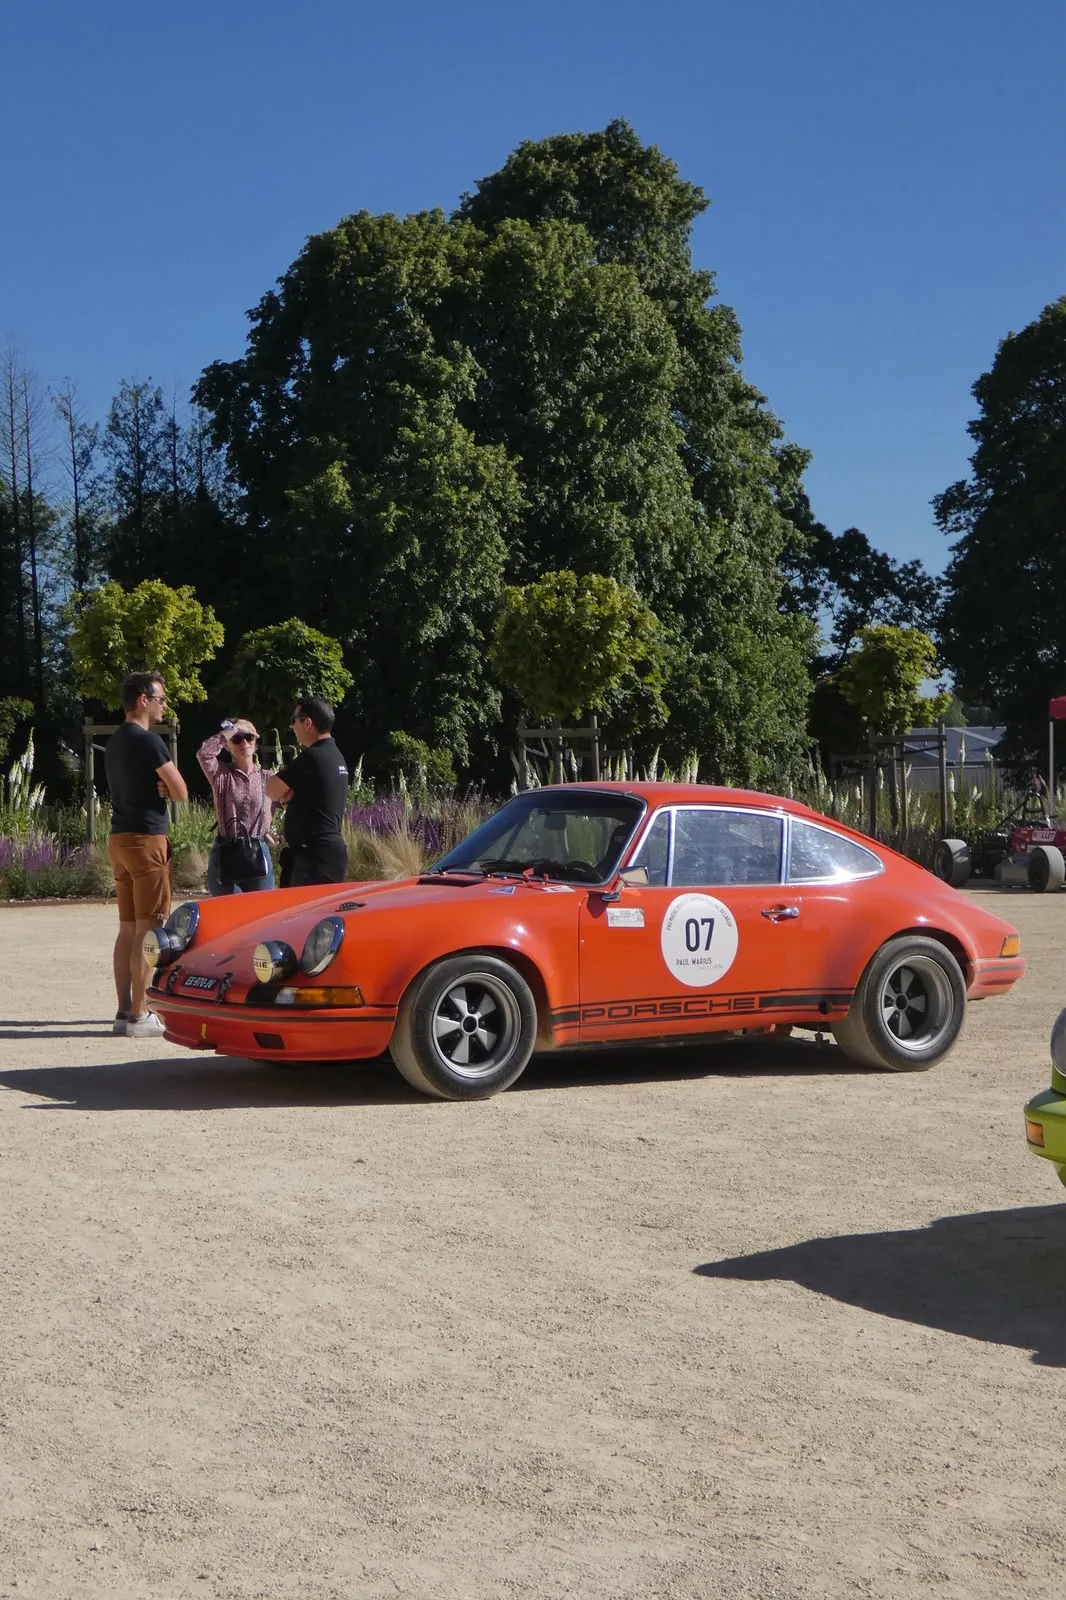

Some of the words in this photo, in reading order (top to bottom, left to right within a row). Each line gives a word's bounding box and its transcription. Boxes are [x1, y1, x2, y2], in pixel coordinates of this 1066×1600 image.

[685, 918, 715, 952] 07
[691, 957, 712, 965] MARIUS
[581, 997, 755, 1022] PORSCHE
